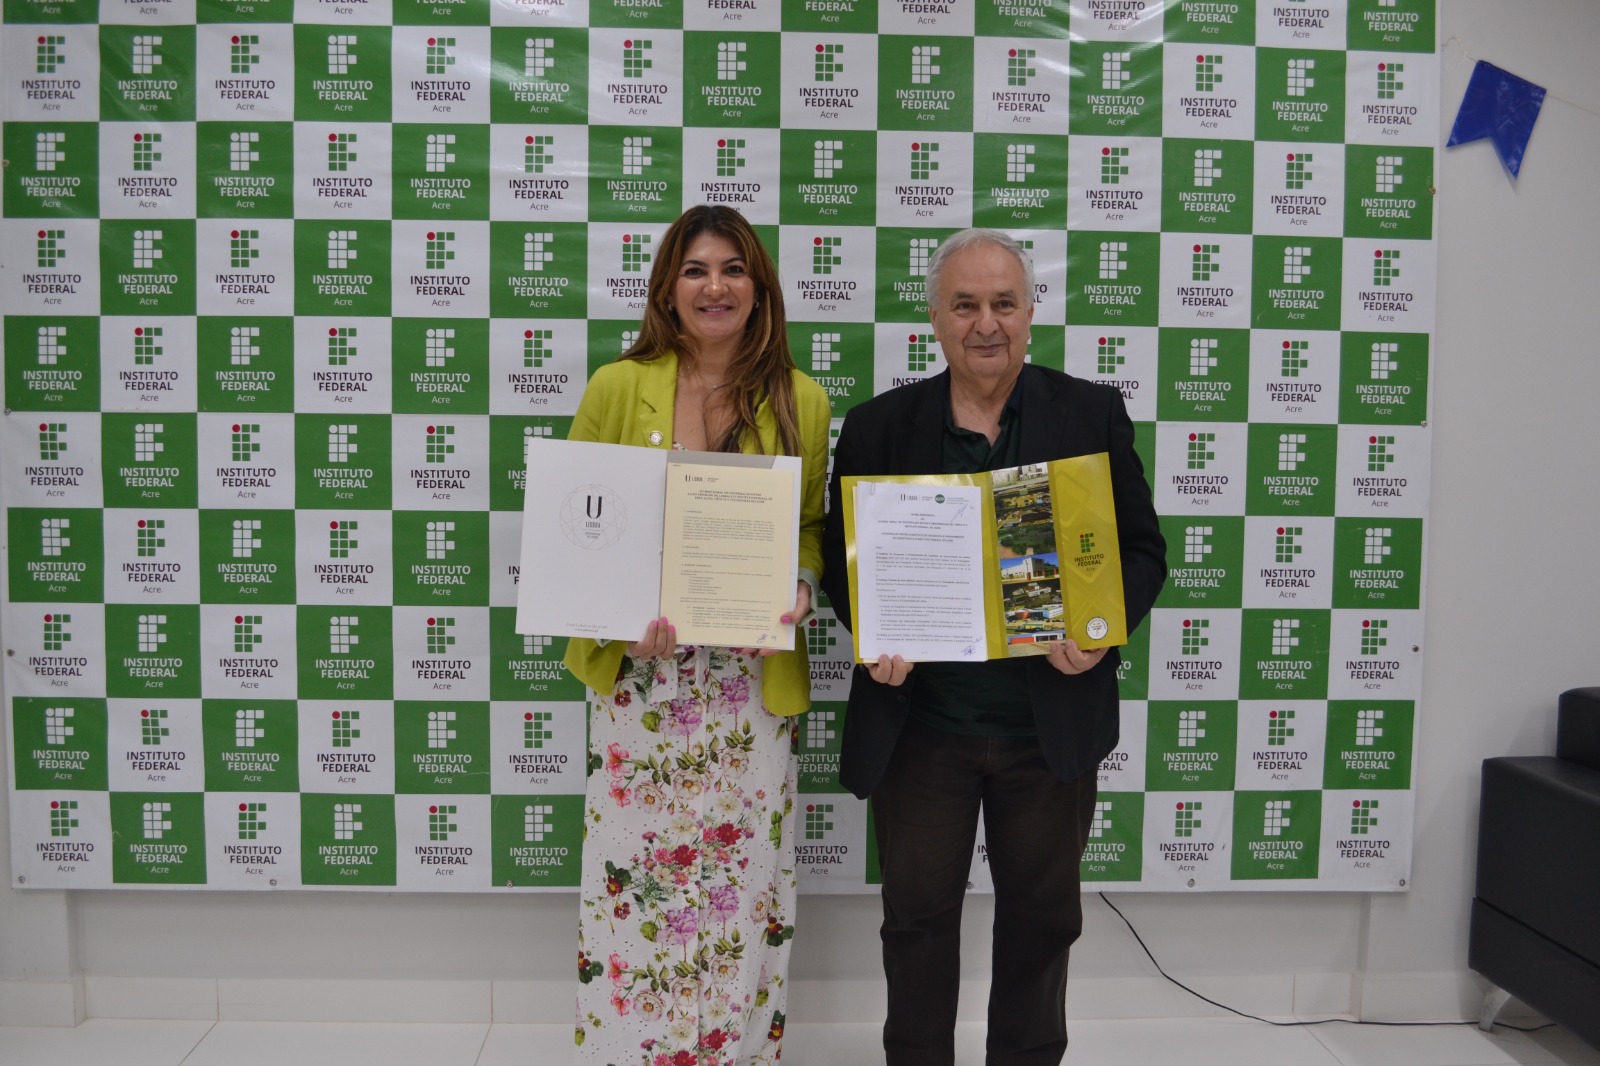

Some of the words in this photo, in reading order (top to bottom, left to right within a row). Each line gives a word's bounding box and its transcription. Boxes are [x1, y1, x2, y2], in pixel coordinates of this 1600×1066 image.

[1180, 3, 1238, 12] INSTITUTO
[1273, 8, 1329, 17] INSTITUTO
[1186, 13, 1233, 22] FEDERAL
[1278, 18, 1323, 27] FEDERAL
[214, 80, 275, 89] INSTITUTO
[312, 81, 373, 90] INSTITUTO
[607, 84, 667, 94] INSTITUTO
[220, 90, 269, 99] FEDERAL
[318, 91, 368, 100] FEDERAL
[701, 86, 761, 96] INSTITUTO
[613, 94, 662, 104] FEDERAL
[707, 96, 756, 106] FEDERAL
[992, 93, 1050, 102] INSTITUTO
[1086, 95, 1145, 105] INSTITUTO
[628, 107, 647, 115] Acre
[997, 103, 1045, 112] FEDERAL
[1092, 105, 1139, 115] FEDERAL
[1362, 105, 1417, 114] INSTITUTO
[1367, 115, 1412, 124] FEDERAL
[20, 177, 80, 186] INSTITUTO
[117, 177, 177, 187] INSTITUTO
[410, 178, 471, 188] INSTITUTO
[508, 180, 569, 189] INSTITUTO
[26, 187, 75, 196] FEDERAL
[123, 187, 172, 197] FEDERAL
[416, 188, 465, 198] FEDERAL
[514, 190, 563, 199] FEDERAL
[797, 185, 858, 194] INSTITUTO
[895, 186, 953, 196] INSTITUTO
[803, 195, 852, 204] FEDERAL
[900, 196, 948, 206] FEDERAL
[1178, 193, 1235, 202] INSTITUTO
[1270, 195, 1326, 205] INSTITUTO
[431, 201, 450, 209] Acre
[1184, 203, 1230, 212] FEDERAL
[1275, 205, 1321, 215] FEDERAL
[215, 274, 275, 284] INSTITUTO
[312, 275, 372, 284] INSTITUTO
[221, 284, 270, 294] FEDERAL
[318, 285, 367, 294] FEDERAL
[1083, 285, 1141, 295] INSTITUTO
[1088, 295, 1136, 305] FEDERAL
[1358, 292, 1413, 302] INSTITUTO
[1363, 302, 1407, 312] FEDERAL
[22, 371, 82, 381] INSTITUTO
[119, 371, 178, 381] INSTITUTO
[410, 373, 470, 383] INSTITUTO
[508, 374, 567, 384] INSTITUTO
[28, 381, 77, 391] FEDERAL
[125, 381, 173, 391] FEDERAL
[416, 383, 465, 393] FEDERAL
[514, 384, 562, 394] FEDERAL
[1174, 382, 1231, 391] INSTITUTO
[1266, 383, 1321, 392] INSTITUTO
[431, 396, 450, 404] Acre
[1179, 392, 1226, 401] FEDERAL
[1271, 393, 1316, 402] FEDERAL
[216, 468, 276, 477] INSTITUTO
[313, 469, 373, 478] INSTITUTO
[222, 478, 270, 487] FEDERAL
[319, 479, 367, 488] FEDERAL
[1352, 477, 1406, 487] INSTITUTO
[1357, 487, 1401, 497] FEDERAL
[586, 495, 602, 519] U
[1075, 554, 1105, 562] INSTITUTO
[27, 562, 86, 571] INSTITUTO
[122, 563, 181, 573] INSTITUTO
[411, 565, 471, 575] INSTITUTO
[32, 572, 80, 581] FEDERAL
[127, 573, 175, 583] FEDERAL
[1168, 568, 1225, 578] INSTITUTO
[1260, 569, 1315, 578] INSTITUTO
[416, 575, 465, 585] FEDERAL
[1174, 578, 1220, 588] FEDERAL
[1265, 579, 1309, 588] FEDERAL
[219, 658, 278, 668] INSTITUTO
[315, 659, 374, 669] INSTITUTO
[1345, 661, 1399, 670] INSTITUTO
[225, 668, 273, 678] FEDERAL
[320, 669, 369, 679] FEDERAL
[1350, 671, 1394, 680] FEDERAL
[32, 749, 89, 759] INSTITUTO
[126, 752, 185, 761] INSTITUTO
[412, 754, 472, 763] INSTITUTO
[1162, 752, 1218, 762] INSTITUTO
[1252, 751, 1307, 761] INSTITUTO
[38, 759, 85, 769] FEDERAL
[509, 755, 567, 764] INSTITUTO
[132, 762, 180, 771] FEDERAL
[418, 764, 467, 773] FEDERAL
[514, 765, 562, 774] FEDERAL
[1167, 762, 1213, 772] FEDERAL
[1257, 761, 1302, 771] FEDERAL
[1336, 839, 1390, 849] INSTITUTO
[224, 845, 281, 855] INSTITUTO
[318, 845, 378, 855] INSTITUTO
[1340, 849, 1384, 859] FEDERAL
[229, 855, 276, 865] FEDERAL
[324, 855, 372, 865] FEDERAL
[245, 868, 263, 876] Acre
